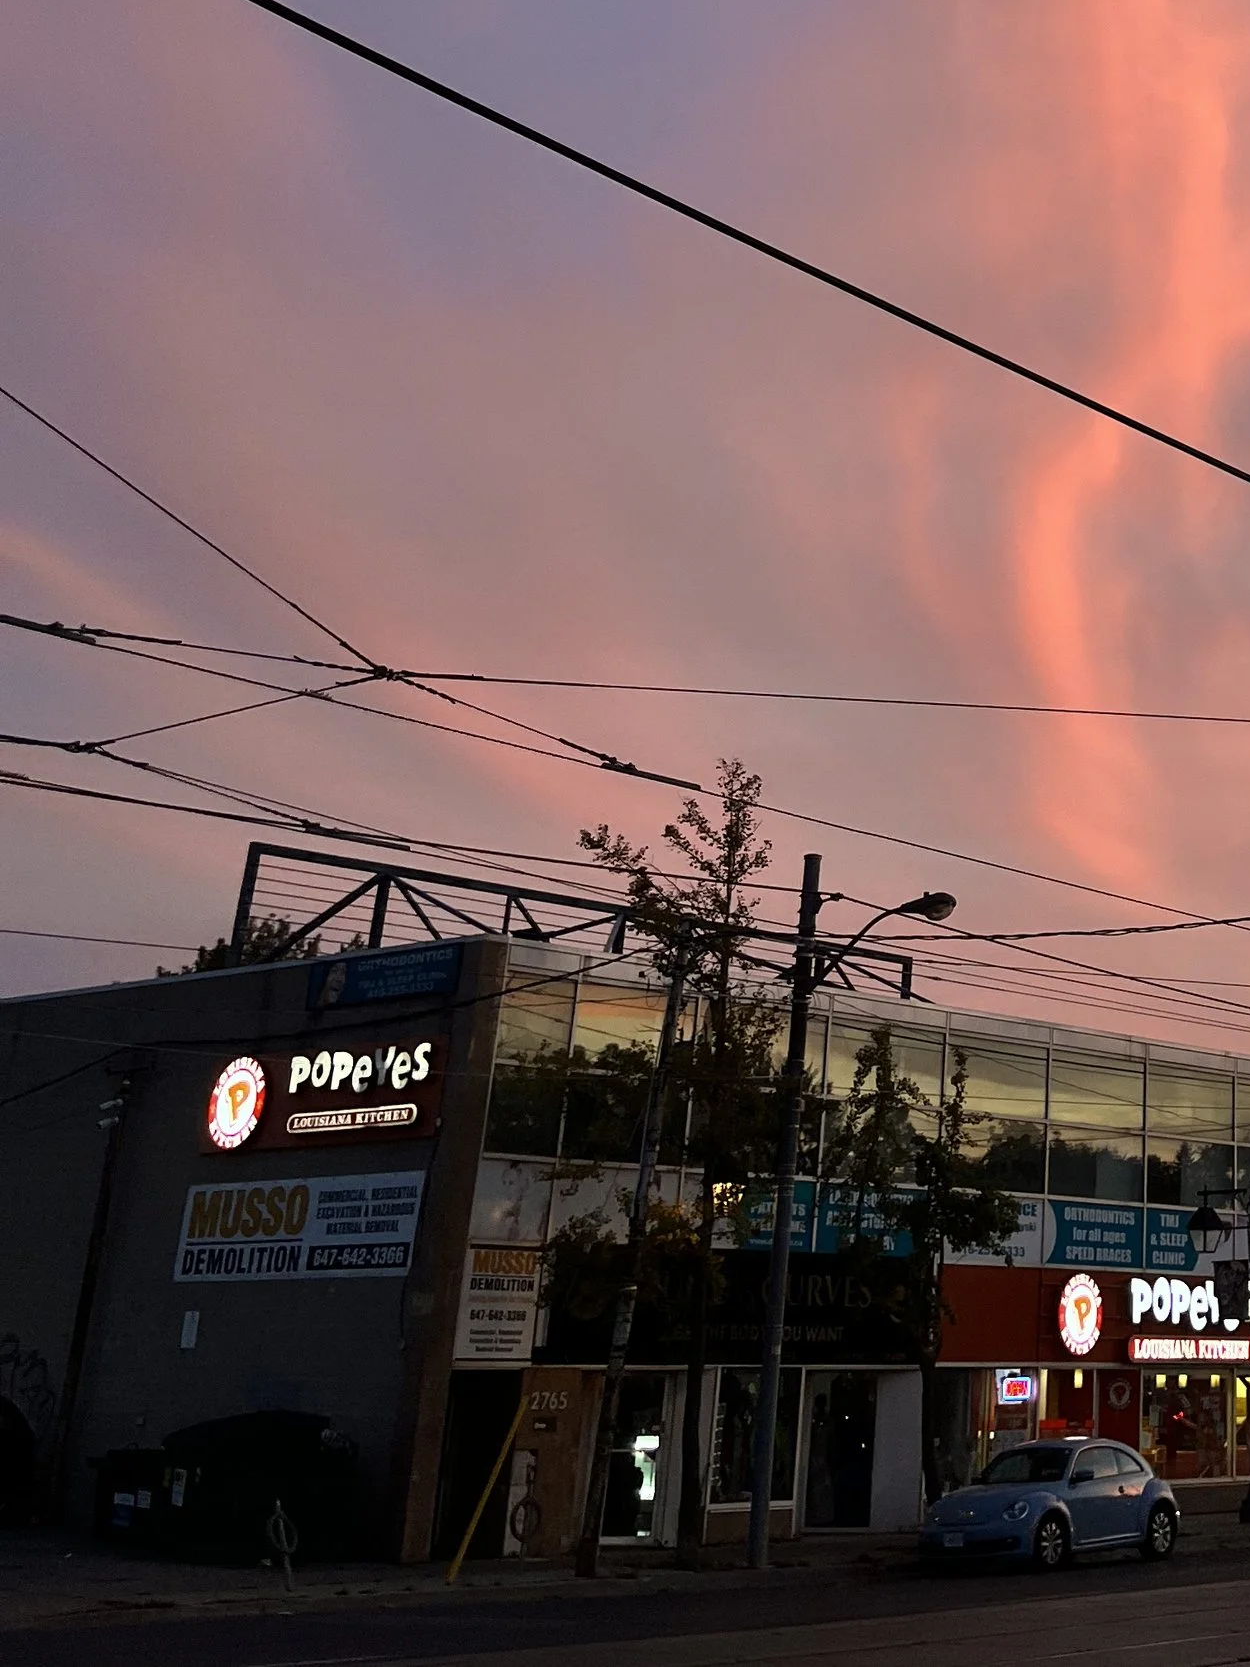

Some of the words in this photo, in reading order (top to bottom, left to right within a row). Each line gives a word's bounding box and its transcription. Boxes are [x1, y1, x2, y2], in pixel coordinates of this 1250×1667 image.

[293, 1115, 352, 1130] LOUISIANA
[355, 1109, 410, 1124] KITCHEN
[188, 1184, 311, 1239] MUSSO
[316, 1204, 362, 1220] EXCAVATION
[1064, 1206, 1135, 1225] ORTHODONTICS
[1160, 1213, 1179, 1228] TMJ
[1072, 1227, 1086, 1242] for
[1087, 1228, 1100, 1242] all
[1102, 1230, 1127, 1245] ages
[1150, 1233, 1158, 1245] &
[1160, 1233, 1188, 1246] SLEEP
[182, 1244, 303, 1276] DEMOLITION
[312, 1246, 405, 1267] 647-642-3366
[472, 1250, 537, 1275] MUSSO
[1065, 1245, 1094, 1260] SPEED
[1097, 1247, 1132, 1263] BRACES
[1152, 1249, 1185, 1266] CLINIC
[469, 1277, 535, 1292] DEMOLITION
[806, 1326, 845, 1342] WANT
[1134, 1338, 1197, 1360] LOUISIANA
[1199, 1339, 1250, 1361] KITCHEN
[530, 1391, 569, 1411] 2765
